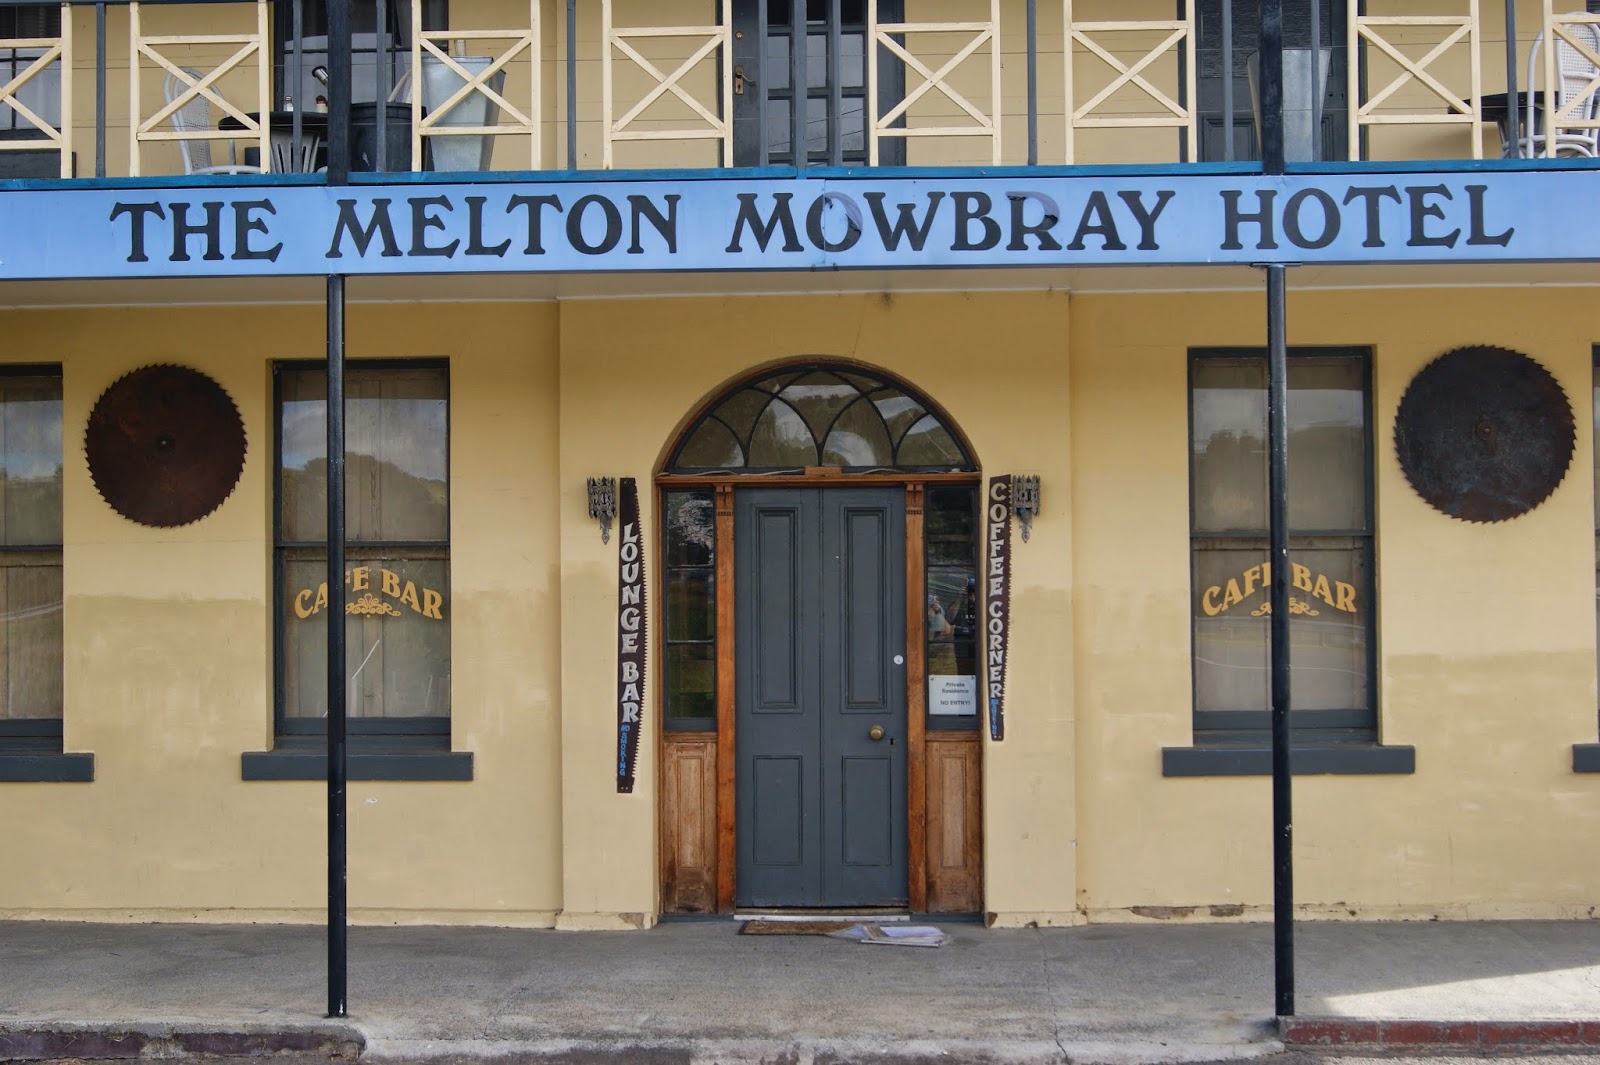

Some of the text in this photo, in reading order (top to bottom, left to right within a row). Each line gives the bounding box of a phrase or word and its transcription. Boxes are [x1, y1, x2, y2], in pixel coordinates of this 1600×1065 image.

[109, 183, 1515, 262] THE MELTON MOWBRAY HOTEL
[989, 482, 1008, 598] COFFEE
[294, 565, 443, 620] CAE BAR
[620, 522, 641, 723] LOUNGE BAR
[1291, 562, 1357, 613] BAR
[988, 600, 1004, 699] CORNER
[619, 724, 631, 776] NO SMOKING
